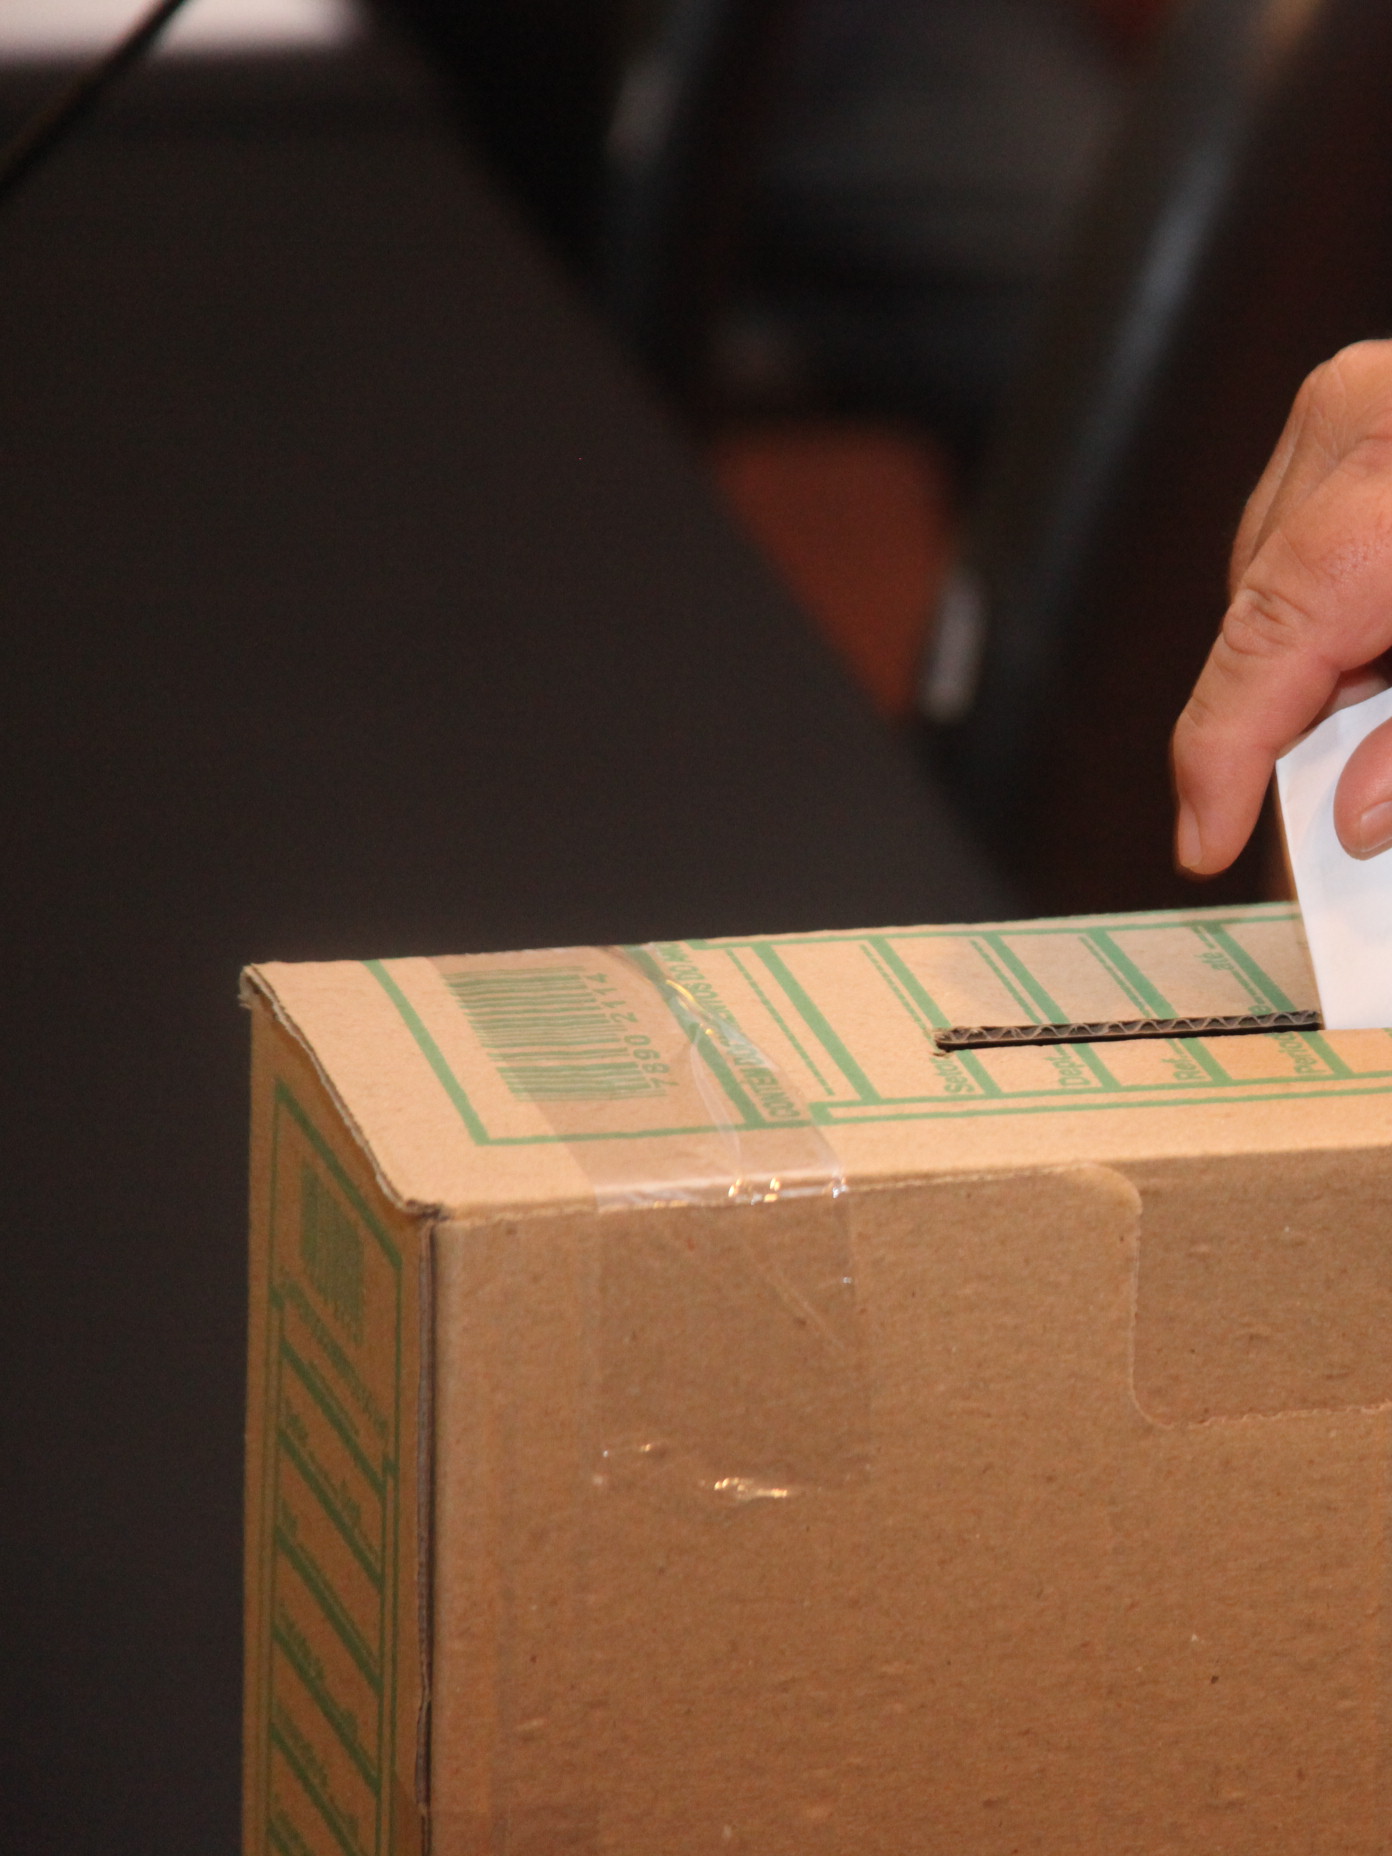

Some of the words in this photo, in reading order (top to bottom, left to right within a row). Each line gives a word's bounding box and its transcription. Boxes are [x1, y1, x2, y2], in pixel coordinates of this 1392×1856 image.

[583, 972, 638, 1023] 2114
[684, 982, 766, 1066] DOCENTOS
[624, 1034, 679, 1089] 7890
[1263, 1032, 1328, 1075] Period
